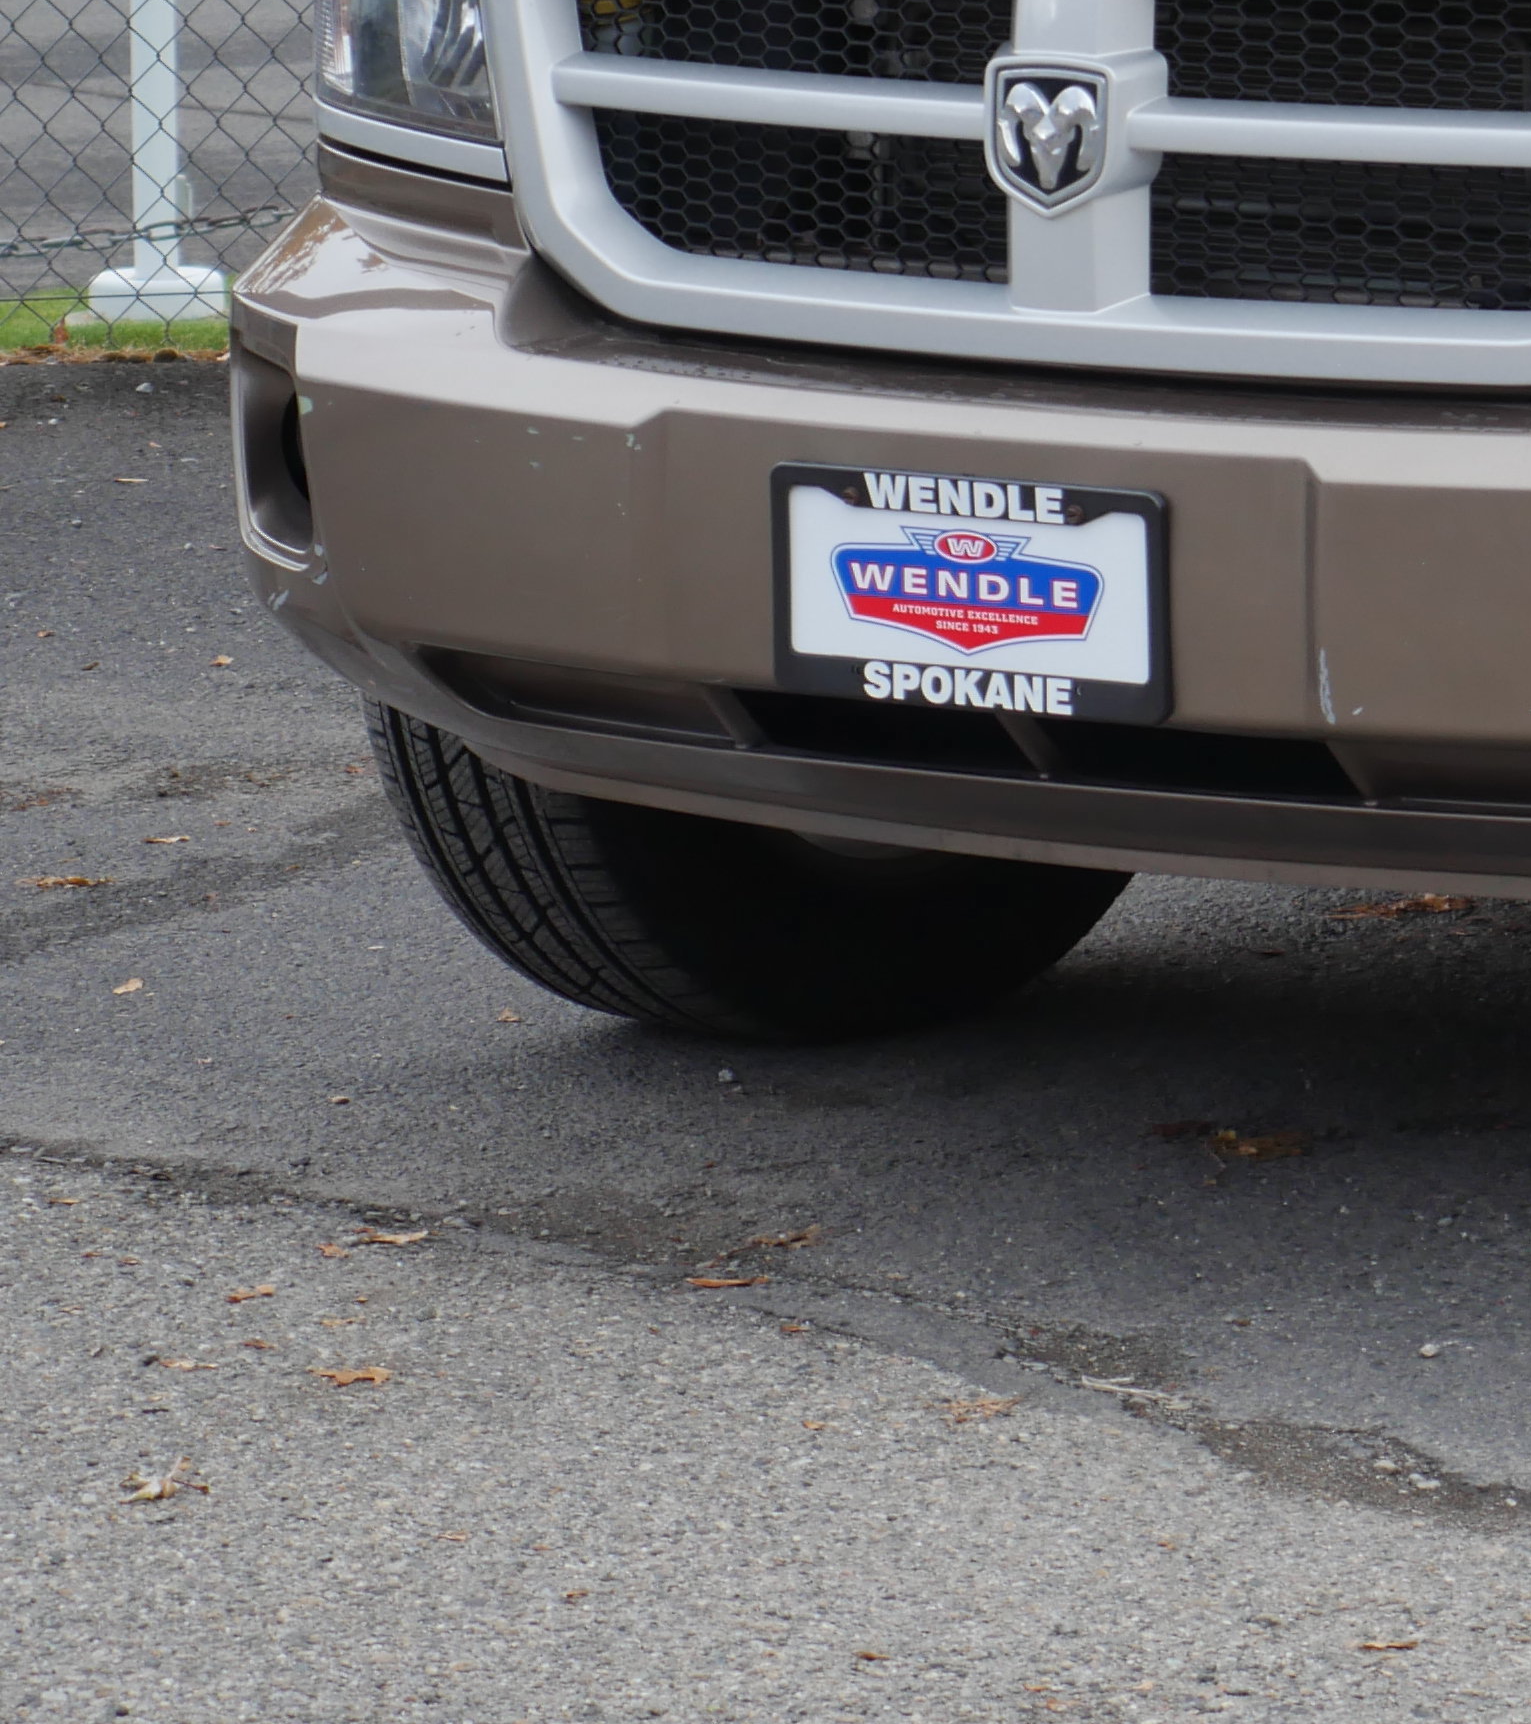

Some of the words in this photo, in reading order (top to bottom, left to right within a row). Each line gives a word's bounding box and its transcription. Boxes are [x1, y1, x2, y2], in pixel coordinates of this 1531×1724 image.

[863, 473, 1065, 524] WENDLE
[849, 562, 1079, 608] WENDLE
[892, 603, 963, 618] AUTOMOTIVE
[967, 610, 1038, 625] EXCELLENCE
[936, 620, 969, 632] SINCE
[972, 624, 998, 634] 1943
[864, 661, 1074, 716] SPOKANE
